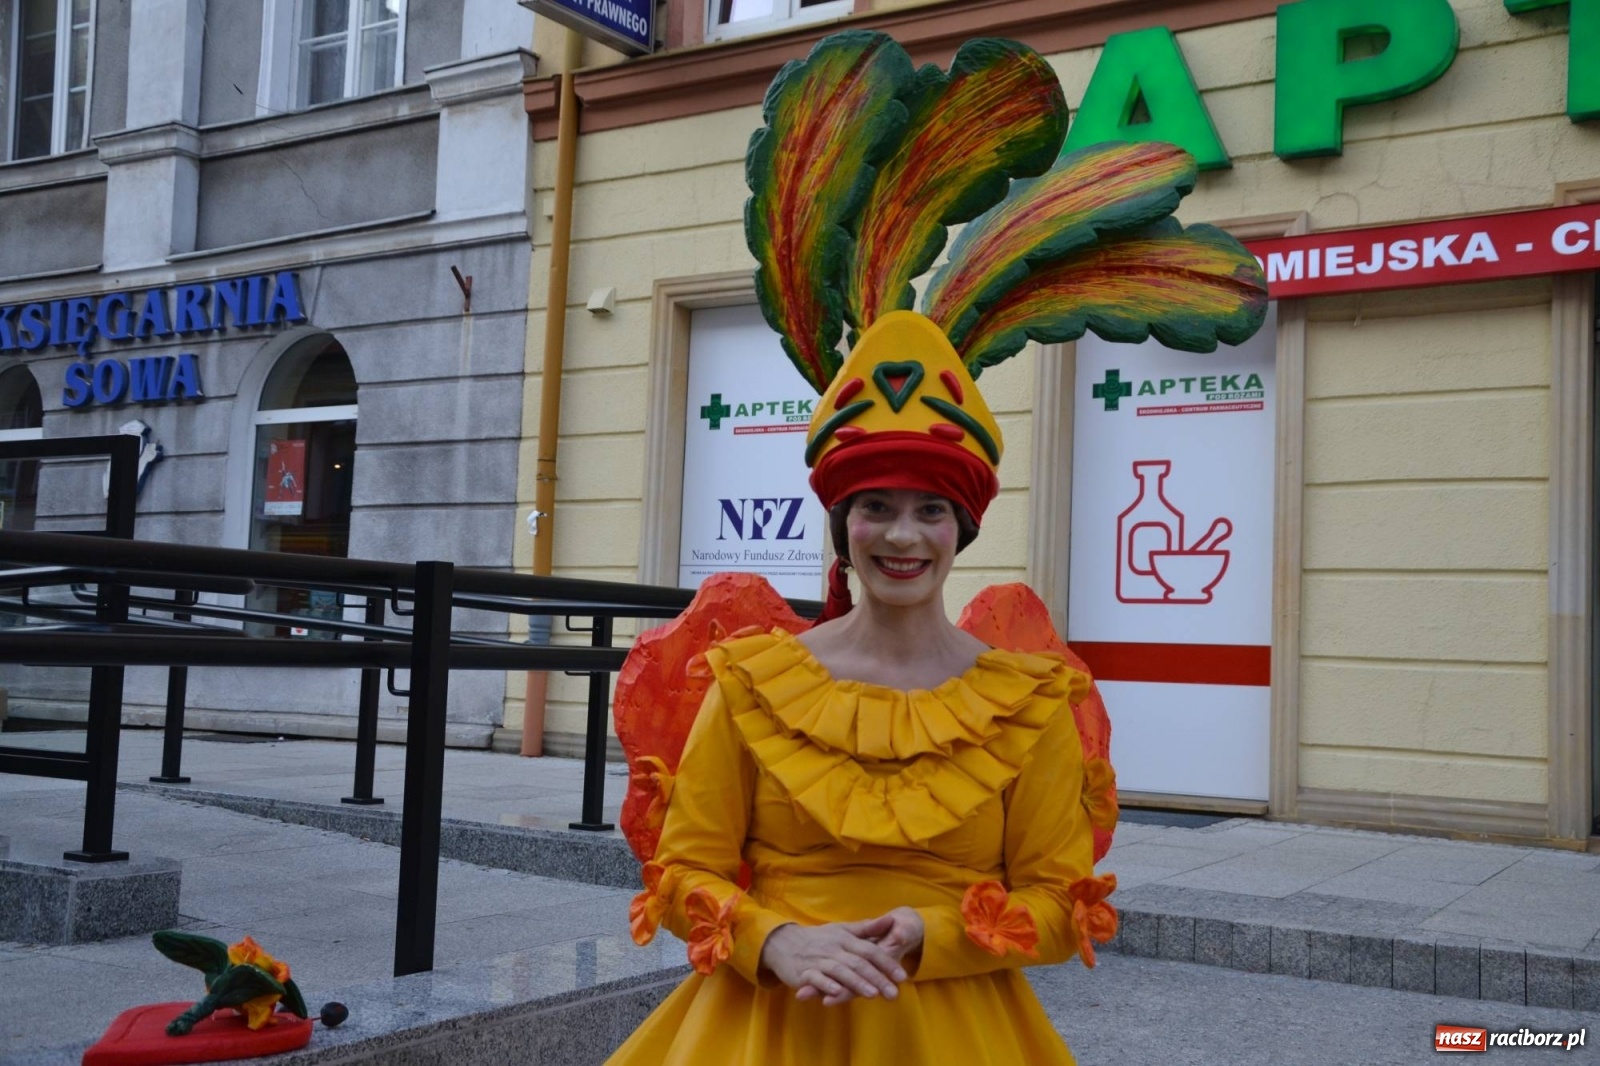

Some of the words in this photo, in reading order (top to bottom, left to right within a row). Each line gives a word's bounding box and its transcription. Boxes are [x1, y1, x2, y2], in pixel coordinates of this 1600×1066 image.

[586, 0, 648, 36] PRAWNEGO
[1254, 231, 1499, 283] MIEJSKA
[1551, 218, 1600, 255] C
[0, 271, 307, 357] KSIĘGARNIA
[63, 353, 204, 408] SOWA
[1137, 373, 1263, 396] APTEKA
[716, 497, 806, 541] NFZ
[692, 549, 741, 563] Narodowy
[743, 549, 785, 561] Fundusz
